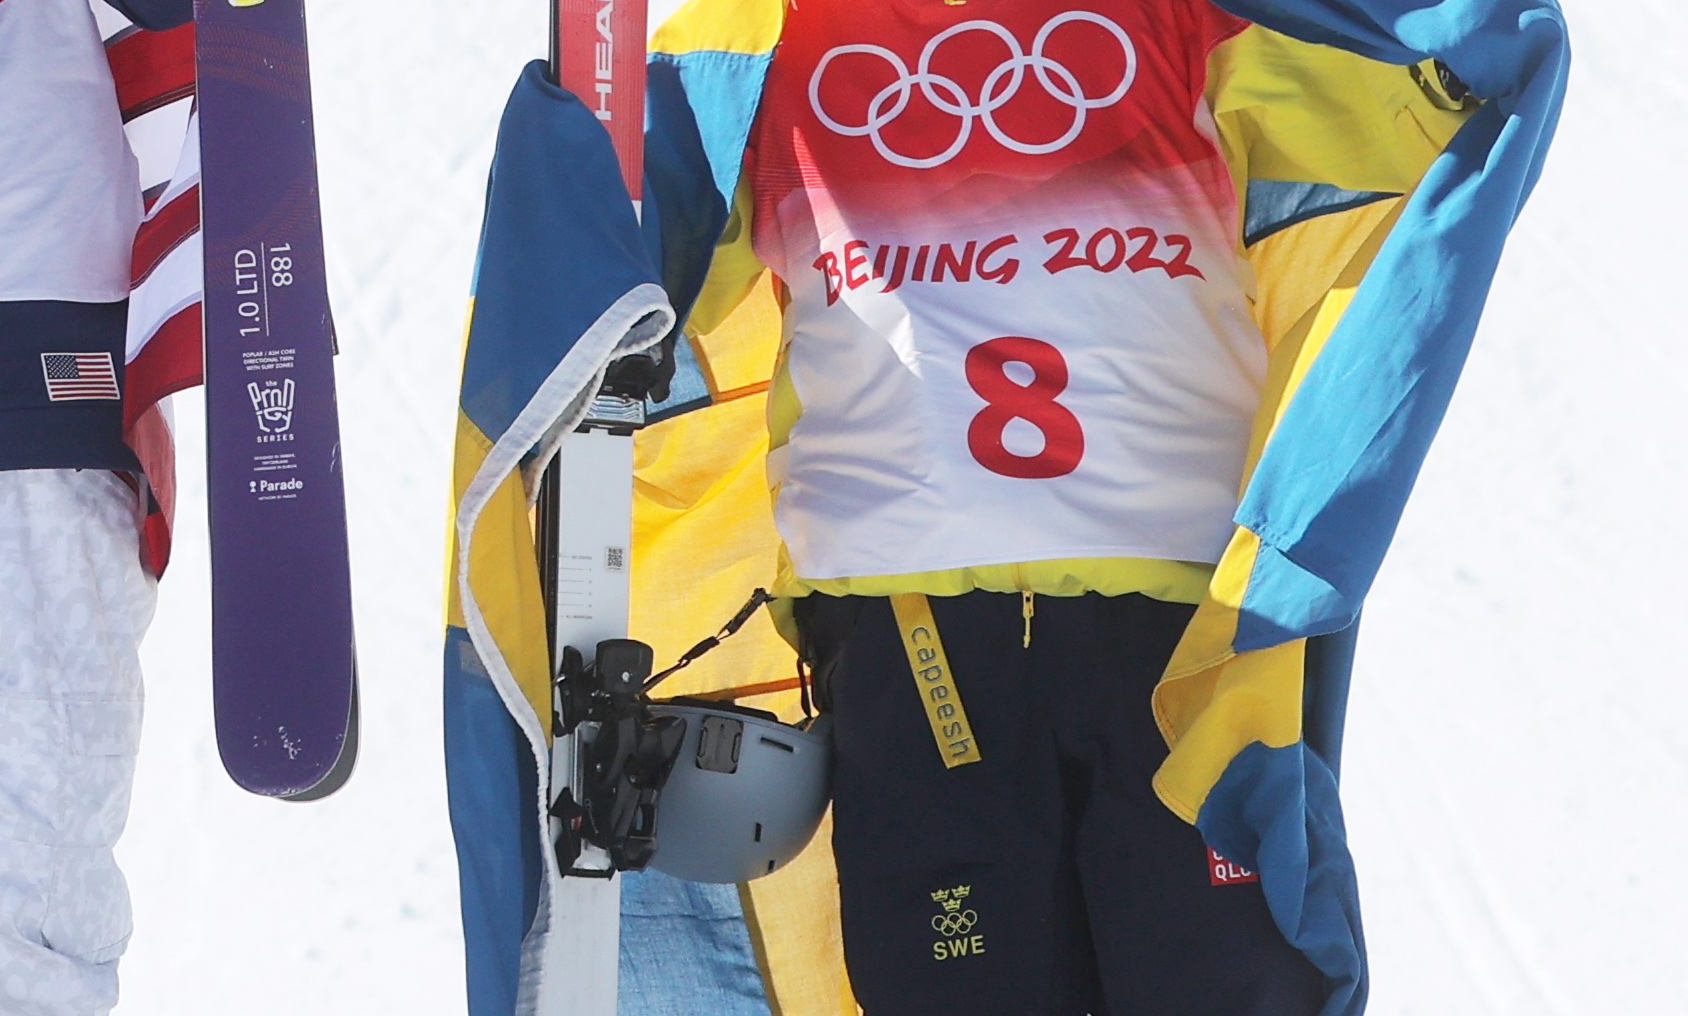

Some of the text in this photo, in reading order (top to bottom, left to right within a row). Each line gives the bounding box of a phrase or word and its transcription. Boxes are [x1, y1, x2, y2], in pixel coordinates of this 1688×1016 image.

[234, 249, 261, 337] 1.0 LTD
[270, 242, 294, 287] 188
[812, 226, 1208, 308] BEIJING 2022
[256, 433, 294, 443] SERIES
[965, 336, 1085, 479] 8
[260, 477, 303, 492] Parade
[911, 626, 971, 758] capeesh
[933, 934, 986, 961] SWE
